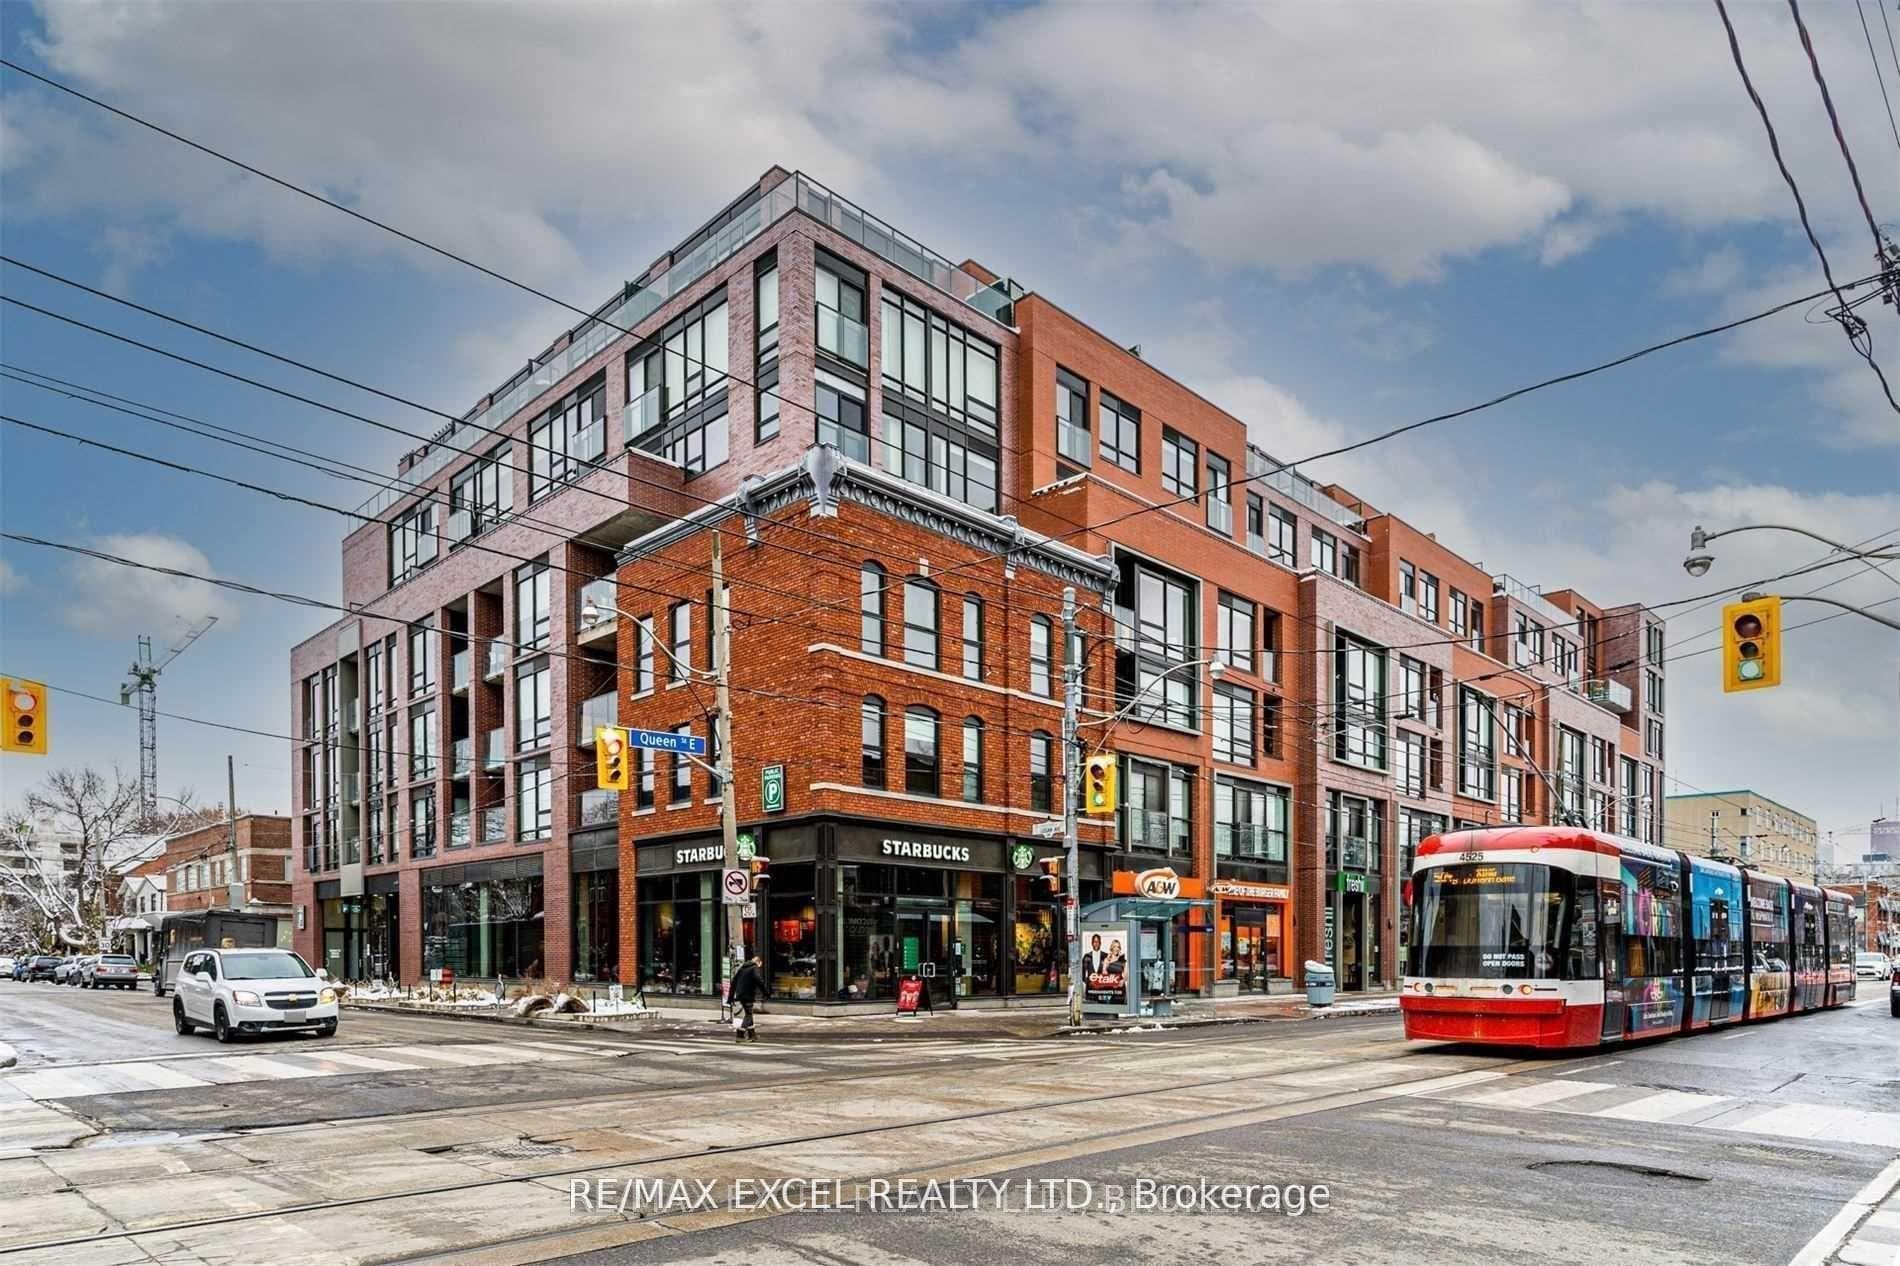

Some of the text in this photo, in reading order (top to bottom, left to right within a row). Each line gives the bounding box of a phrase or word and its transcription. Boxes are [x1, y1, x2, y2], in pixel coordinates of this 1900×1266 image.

[640, 733, 677, 748] Queen
[689, 738, 696, 750] E
[769, 783, 778, 801] P
[676, 845, 726, 864] STARBU
[882, 839, 970, 862] STARBUCKS
[1459, 852, 1484, 861] 4525
[1146, 880, 1176, 895] A&W
